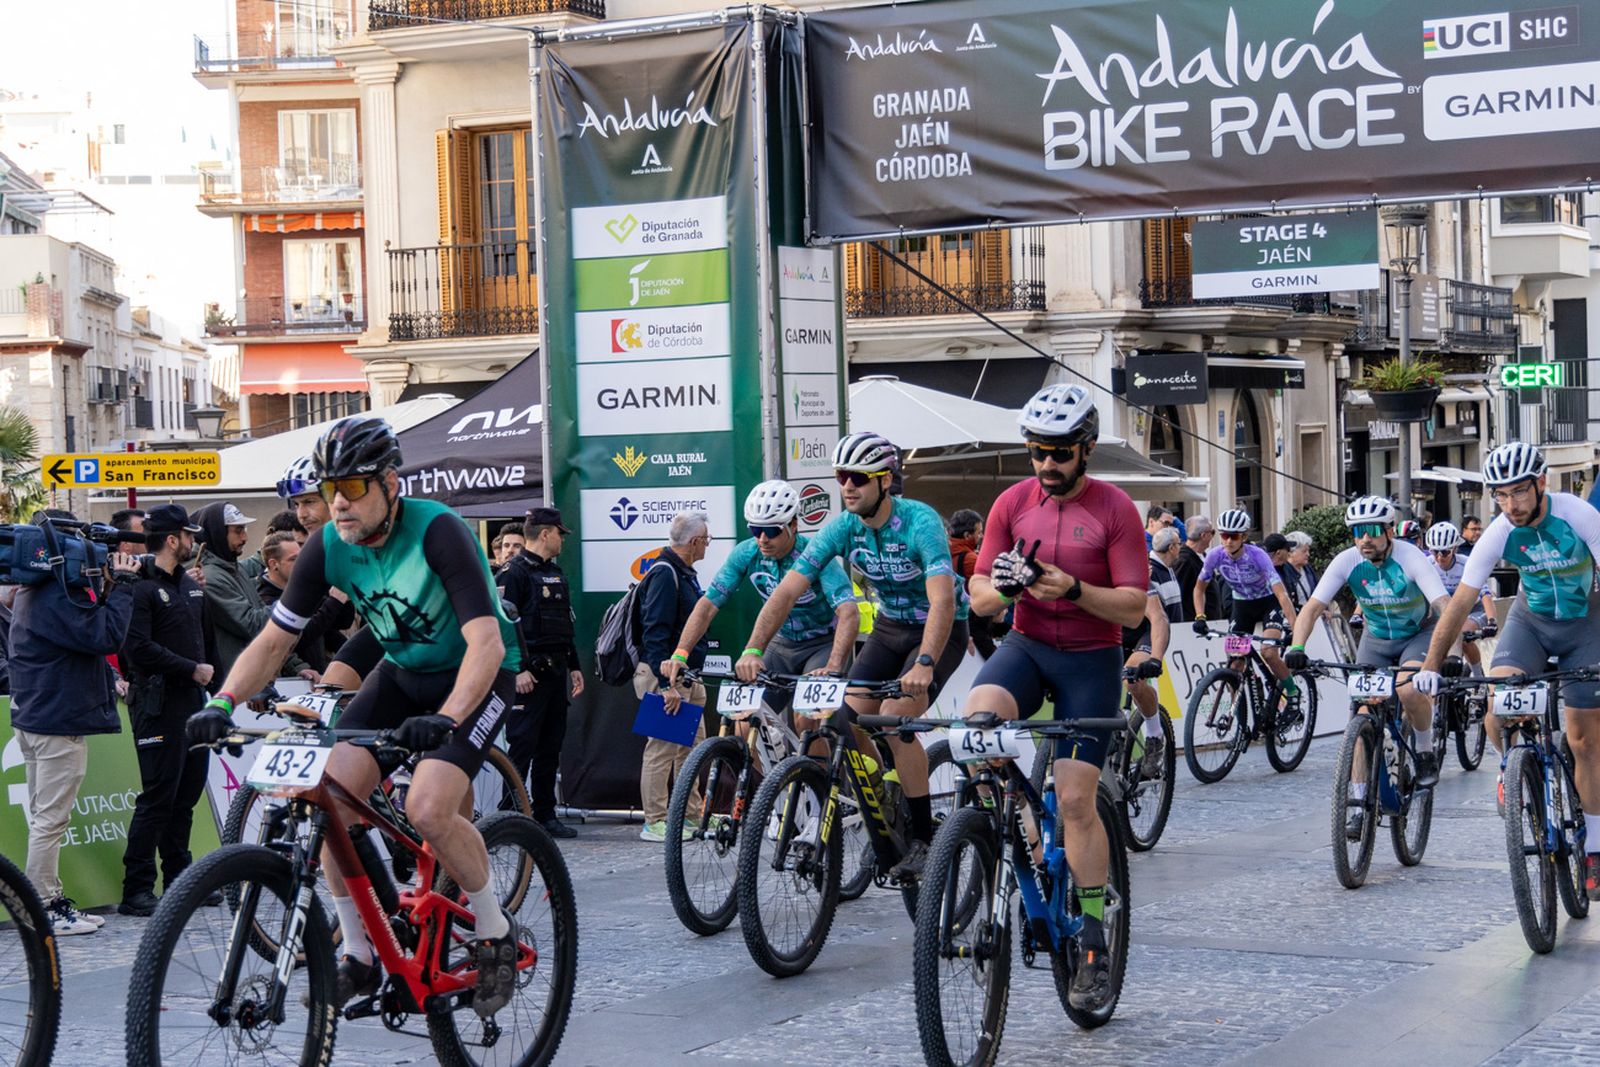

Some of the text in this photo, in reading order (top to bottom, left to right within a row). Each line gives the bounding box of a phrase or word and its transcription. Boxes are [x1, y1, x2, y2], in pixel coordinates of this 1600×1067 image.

[1438, 15, 1568, 51] UCI SHC
[845, 29, 943, 62] Andalucía
[1035, 0, 1403, 107] Andalucía
[873, 87, 971, 118] GRANADA
[1445, 83, 1595, 118] GARMIN
[577, 90, 719, 139] Andalucía
[895, 117, 950, 150] JAÉN
[1043, 82, 1422, 171] BIKE RACE BY
[875, 152, 973, 183] CÓRDOBA
[642, 217, 700, 233] Diputación
[1239, 222, 1327, 244] STAGE 4
[642, 229, 703, 243] de Granada
[1256, 246, 1311, 265] JAÉN
[1251, 274, 1319, 289] GARMIN
[648, 322, 702, 336] Diputación
[785, 328, 832, 345] GARMIN
[647, 336, 703, 348] de Córdoba
[1501, 366, 1561, 386] CERI
[597, 383, 716, 410] GARMIN
[651, 453, 707, 464] CAJA RURAL
[800, 438, 826, 459] Jaén
[80, 461, 96, 481] P
[106, 457, 216, 466] aparcamiento municipal
[668, 465, 692, 476] JAÉN
[105, 468, 216, 481] San Francisco
[642, 500, 707, 512] SCIENTIFFIC
[1521, 557, 1579, 572] PREMIUM
[1360, 596, 1410, 604] PREMIUM
[803, 683, 838, 703] 48-2
[1355, 675, 1385, 692] 45-2
[726, 687, 755, 706] 48-1
[1503, 691, 1536, 710] 45-1
[962, 730, 1005, 754] 43-1
[265, 749, 316, 778] 43-2
[84, 819, 128, 843] JAÉN
